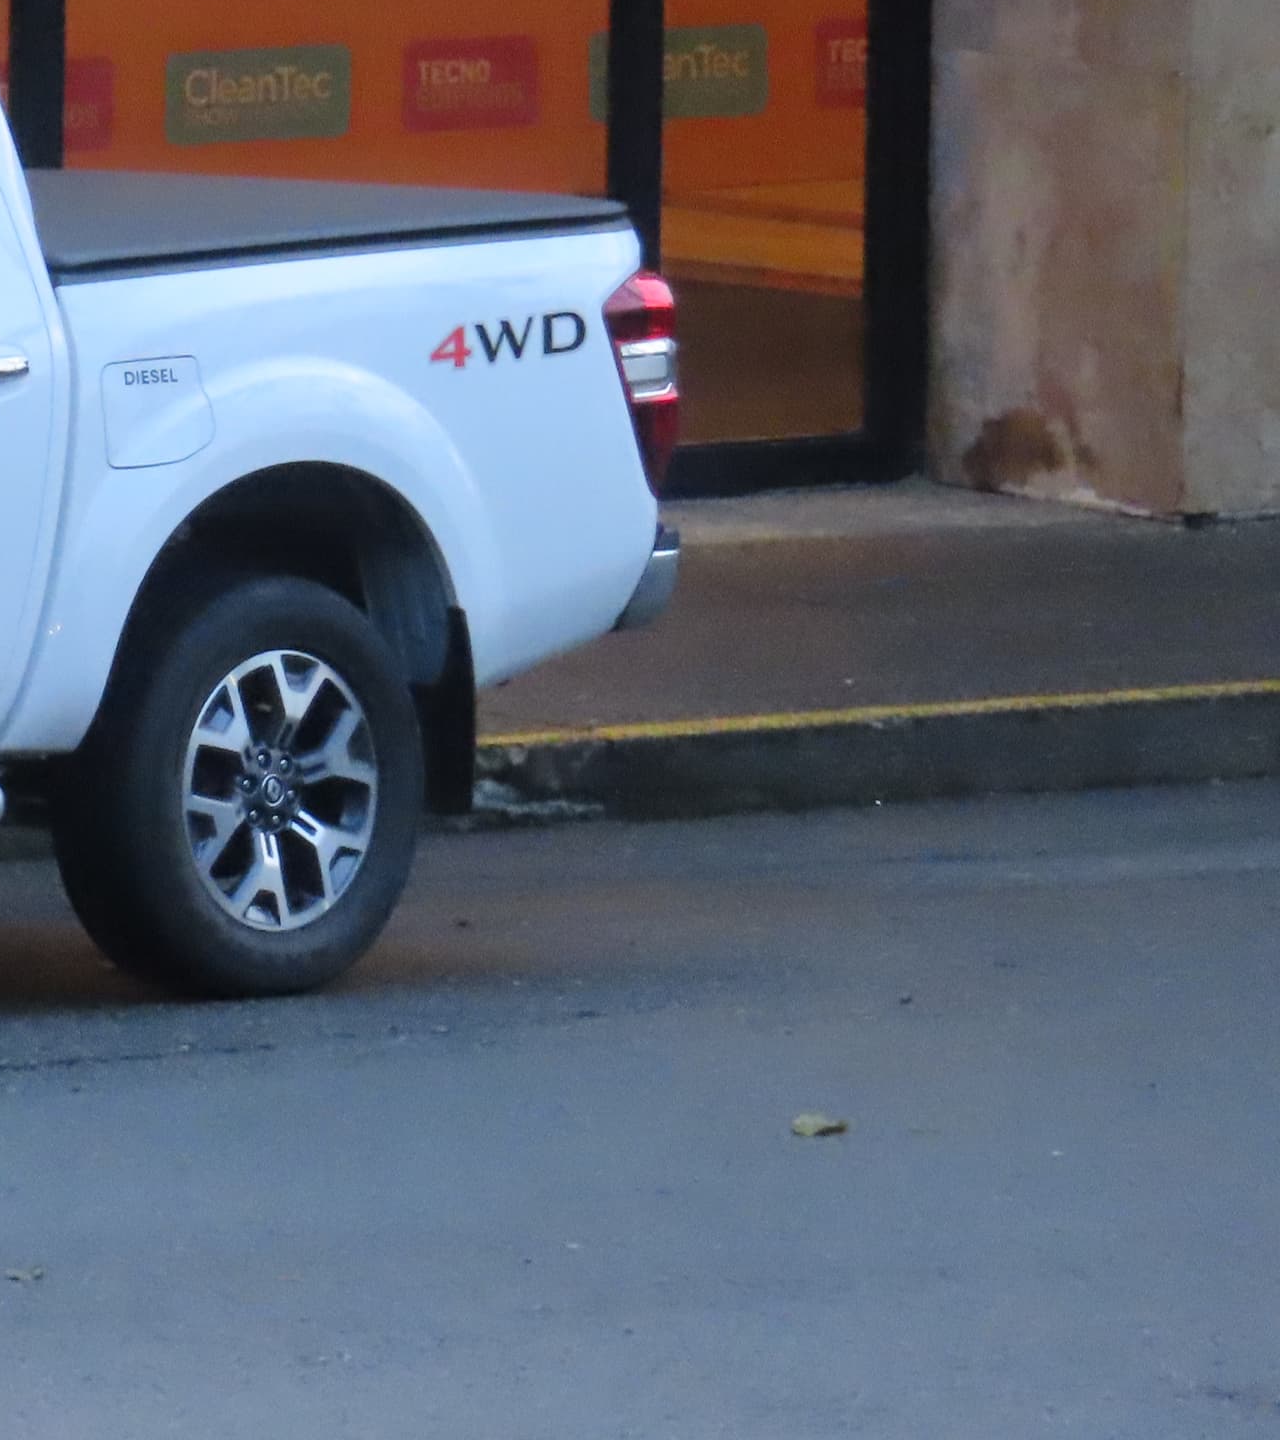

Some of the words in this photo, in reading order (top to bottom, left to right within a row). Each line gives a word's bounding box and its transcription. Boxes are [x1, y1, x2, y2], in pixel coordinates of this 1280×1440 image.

[184, 66, 332, 107] CleanTec
[418, 58, 491, 86] TECNO
[429, 311, 587, 368] 4WD
[124, 368, 179, 386] DIESEL
